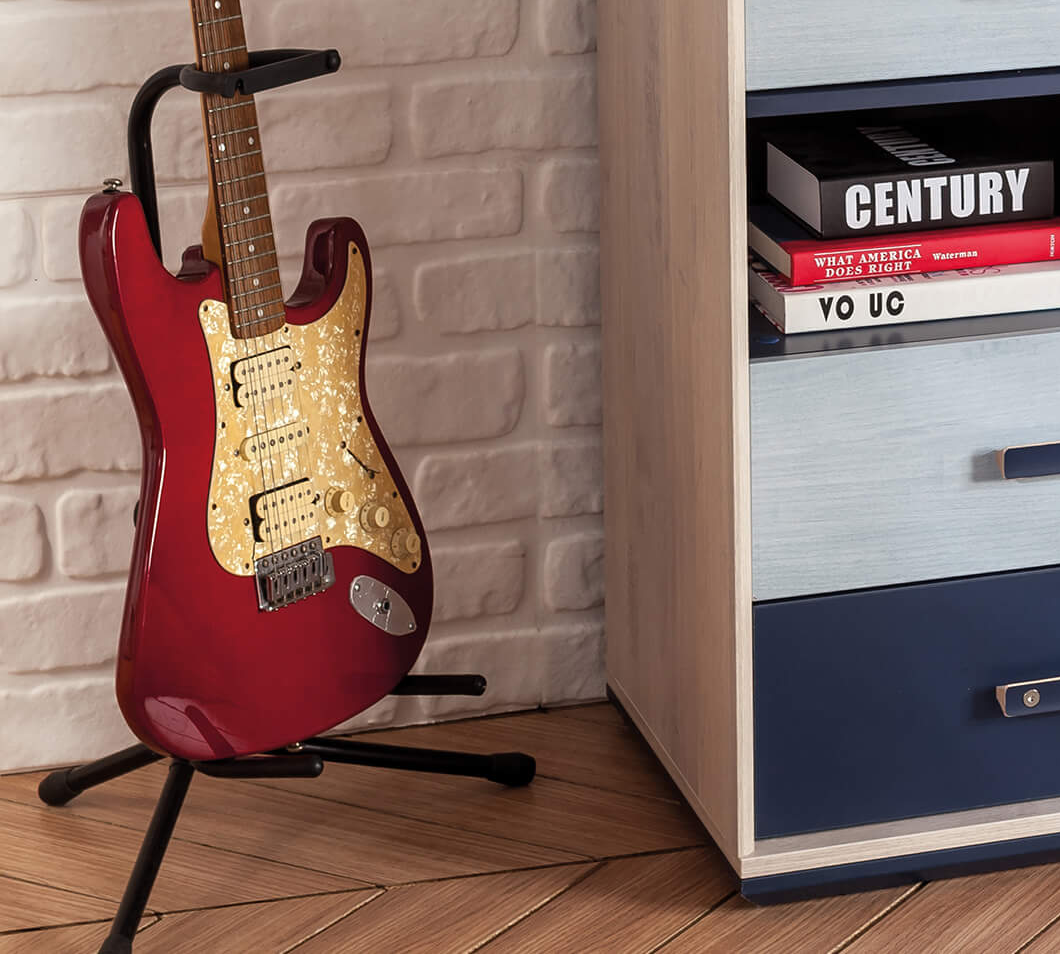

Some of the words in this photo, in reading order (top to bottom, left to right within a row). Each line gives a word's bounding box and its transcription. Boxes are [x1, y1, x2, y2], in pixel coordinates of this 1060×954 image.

[845, 167, 1031, 230] CENTURY
[814, 254, 854, 268] WHAT
[859, 248, 922, 264] AMERICA
[932, 250, 978, 261] Waterman
[825, 265, 863, 278] DOES
[868, 260, 912, 274] RIGHT
[819, 294, 855, 323] VO
